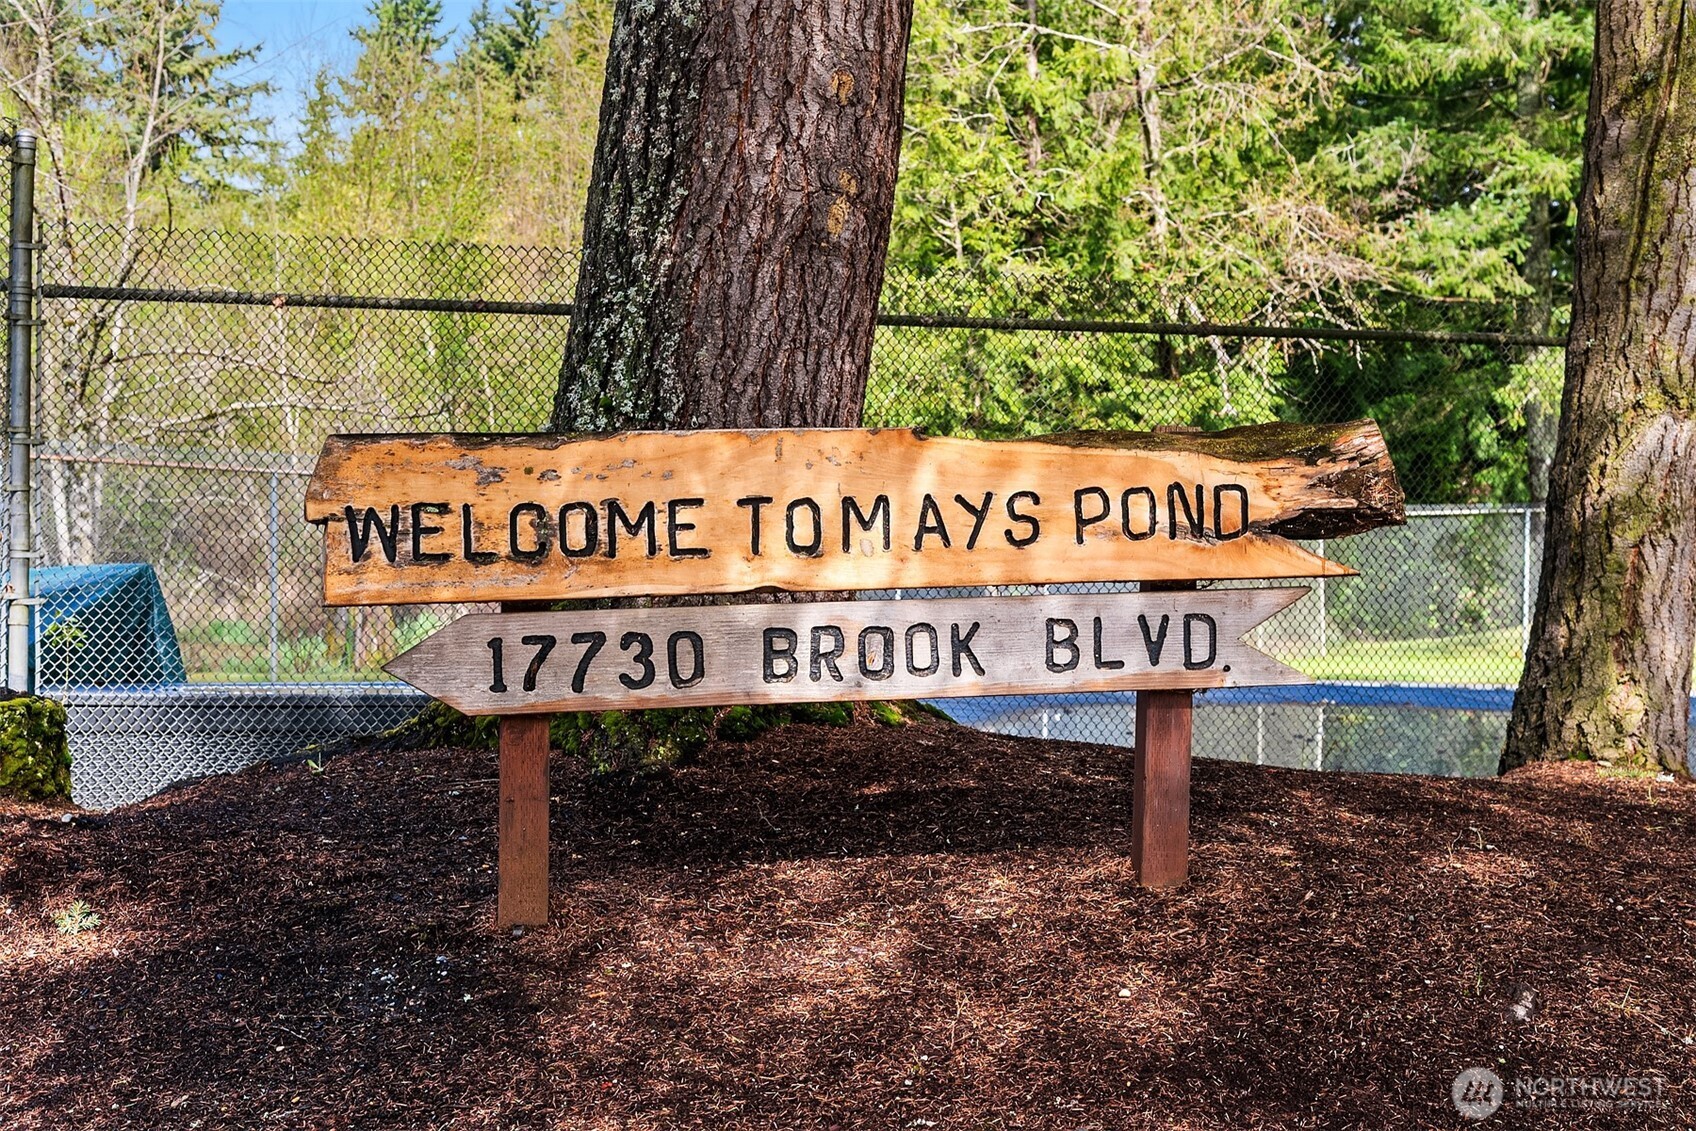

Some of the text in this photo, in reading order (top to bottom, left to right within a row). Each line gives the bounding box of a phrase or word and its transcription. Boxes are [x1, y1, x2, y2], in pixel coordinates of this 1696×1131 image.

[344, 496, 710, 563] WELCOME
[1073, 481, 1249, 545] POND
[487, 611, 1232, 694] 17730 BROOK BLVD.
